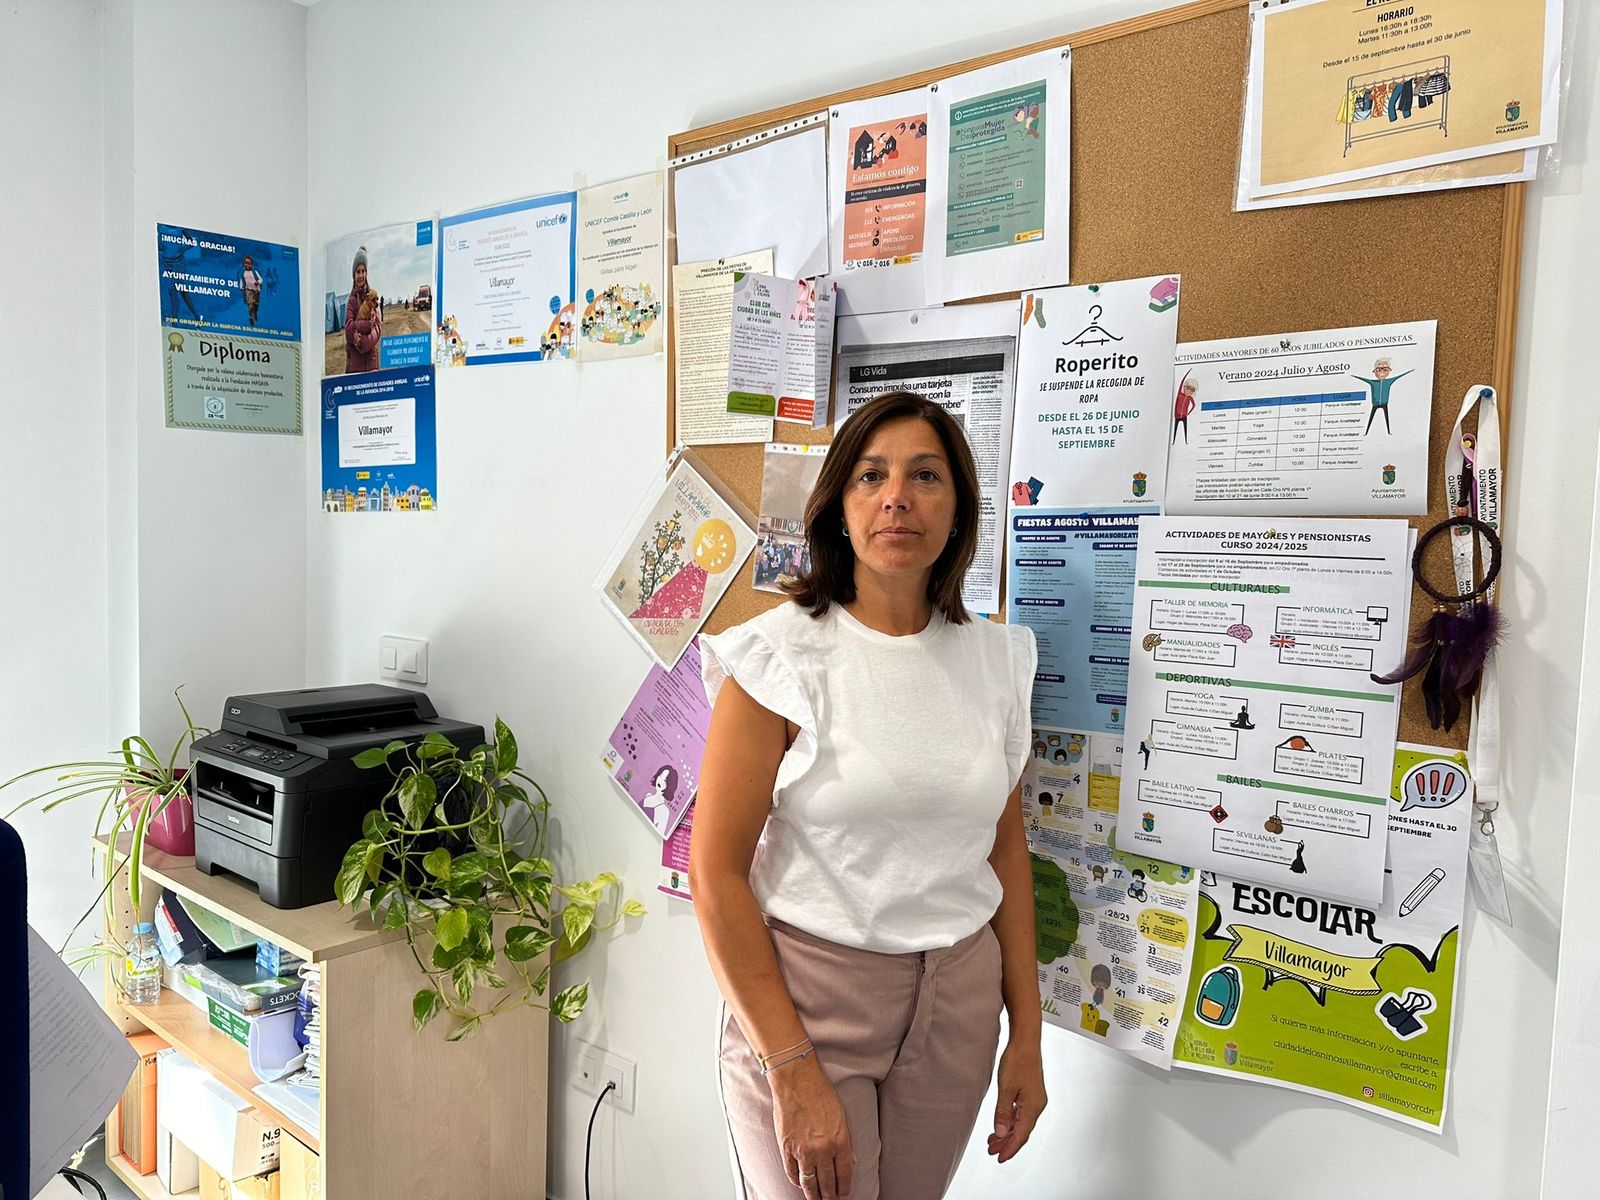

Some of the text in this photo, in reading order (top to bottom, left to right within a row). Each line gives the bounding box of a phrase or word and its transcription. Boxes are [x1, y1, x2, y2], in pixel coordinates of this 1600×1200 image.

[1377, 6, 1414, 23] HORARIO
[1359, 27, 1379, 36] Lunes
[1358, 36, 1380, 45] Martes
[1323, 59, 1343, 69] Desde
[1352, 55, 1360, 63] 15
[1360, 53, 1368, 61] de
[1370, 45, 1405, 59] septiembre
[1407, 40, 1425, 50] hasta
[1434, 35, 1443, 43] 30
[1444, 33, 1453, 41] de
[1454, 29, 1471, 40] junio
[852, 164, 920, 183] Estamos contigo
[535, 214, 560, 230] unicef
[584, 217, 602, 228] UNICEF
[620, 211, 636, 221] Castilla
[641, 208, 652, 216] León
[161, 233, 236, 254] ¡MUCHAS GRACIAS!
[607, 236, 632, 246] Villamayor
[862, 260, 890, 268] 016 016
[162, 270, 239, 288] AYUNTAMIENTO DE
[489, 276, 516, 289] Villamayor
[174, 283, 231, 298] VILLAMAYOR
[737, 306, 754, 315] CIUDAD
[199, 340, 271, 365] Diploma
[1174, 351, 1221, 362] ACTIVIDADES
[1221, 349, 1258, 359] MAYORES
[1302, 340, 1346, 352] JUBILADOS
[1354, 334, 1414, 347] PENSIONISTAS
[1055, 352, 1139, 377] Roperito
[859, 366, 887, 377] LG Vida
[1218, 363, 1351, 380] Verano 2024 Julio y Agosto
[849, 379, 953, 394] Consumo impulsa una tarjeta
[1039, 376, 1145, 392] SE SUSPENDE LA RECOGIDA DE
[928, 390, 951, 400] con la
[1079, 394, 1099, 404] ROPA
[1038, 409, 1140, 423] DESDE EL 26 DE JUNIO
[358, 424, 394, 437] Villamayor
[1052, 424, 1124, 436] HASTA EL 15 DE
[1058, 438, 1116, 449] SEPTIEMBRE
[1478, 468, 1487, 522] AYUNTAMIENTO
[1488, 467, 1498, 522] VILLAMAYOR
[1017, 517, 1052, 528] FIESTAS
[1054, 517, 1090, 527] AGOSTO
[1165, 531, 1372, 543] ACTIVIDADES DE MAYORES Y PENSIONISTAS
[1220, 541, 1308, 552] CURSO 2024/2025
[1210, 582, 1281, 595] CULTURALES
[1163, 599, 1186, 607] TALLER
[1197, 600, 1229, 609] MEMORIA
[1302, 605, 1353, 615] INFORMÁTICA
[1166, 638, 1221, 648] MANUALIDADES
[1312, 643, 1339, 652] INGLÉS
[1165, 672, 1232, 687] DEPORTIVAS
[1192, 691, 1215, 701] YOGA
[1307, 704, 1335, 714] ZUMBA
[1176, 723, 1212, 734] GIMNASIA
[1318, 750, 1347, 761] PILATES
[1073, 773, 1081, 784] 4
[1225, 774, 1263, 788] BAILES
[1151, 779, 1195, 793] BAILE LATINO
[1056, 792, 1064, 803] 7
[1293, 801, 1354, 817] BAILES CHARROS
[1093, 823, 1103, 833] 13
[1409, 818, 1435, 829] HASTA
[1436, 823, 1446, 831] EL
[1446, 824, 1457, 832] 30
[1236, 830, 1277, 843] SEVILLANAS
[1112, 868, 1122, 879] 17
[1147, 862, 1159, 874] 12
[1232, 881, 1384, 945] ESCOLAR
[1139, 925, 1150, 935] 21
[1147, 945, 1157, 955] 33
[1110, 954, 1120, 965] 30
[1265, 940, 1351, 981] Villamayor
[1158, 1016, 1169, 1028] 42
[1270, 1014, 1279, 1023] Si
[1279, 1017, 1308, 1031] quieres
[1308, 1023, 1326, 1035] más
[1326, 1028, 1377, 1050] información
[1378, 1043, 1395, 1056] y/o
[1240, 1058, 1274, 1073] Villamayor
[1273, 1040, 1438, 1092] ciudaddelosninosvillamayor@gmail.com
[1399, 1061, 1430, 1077] escribe
[1378, 1092, 1436, 1117] villamayorcdn
